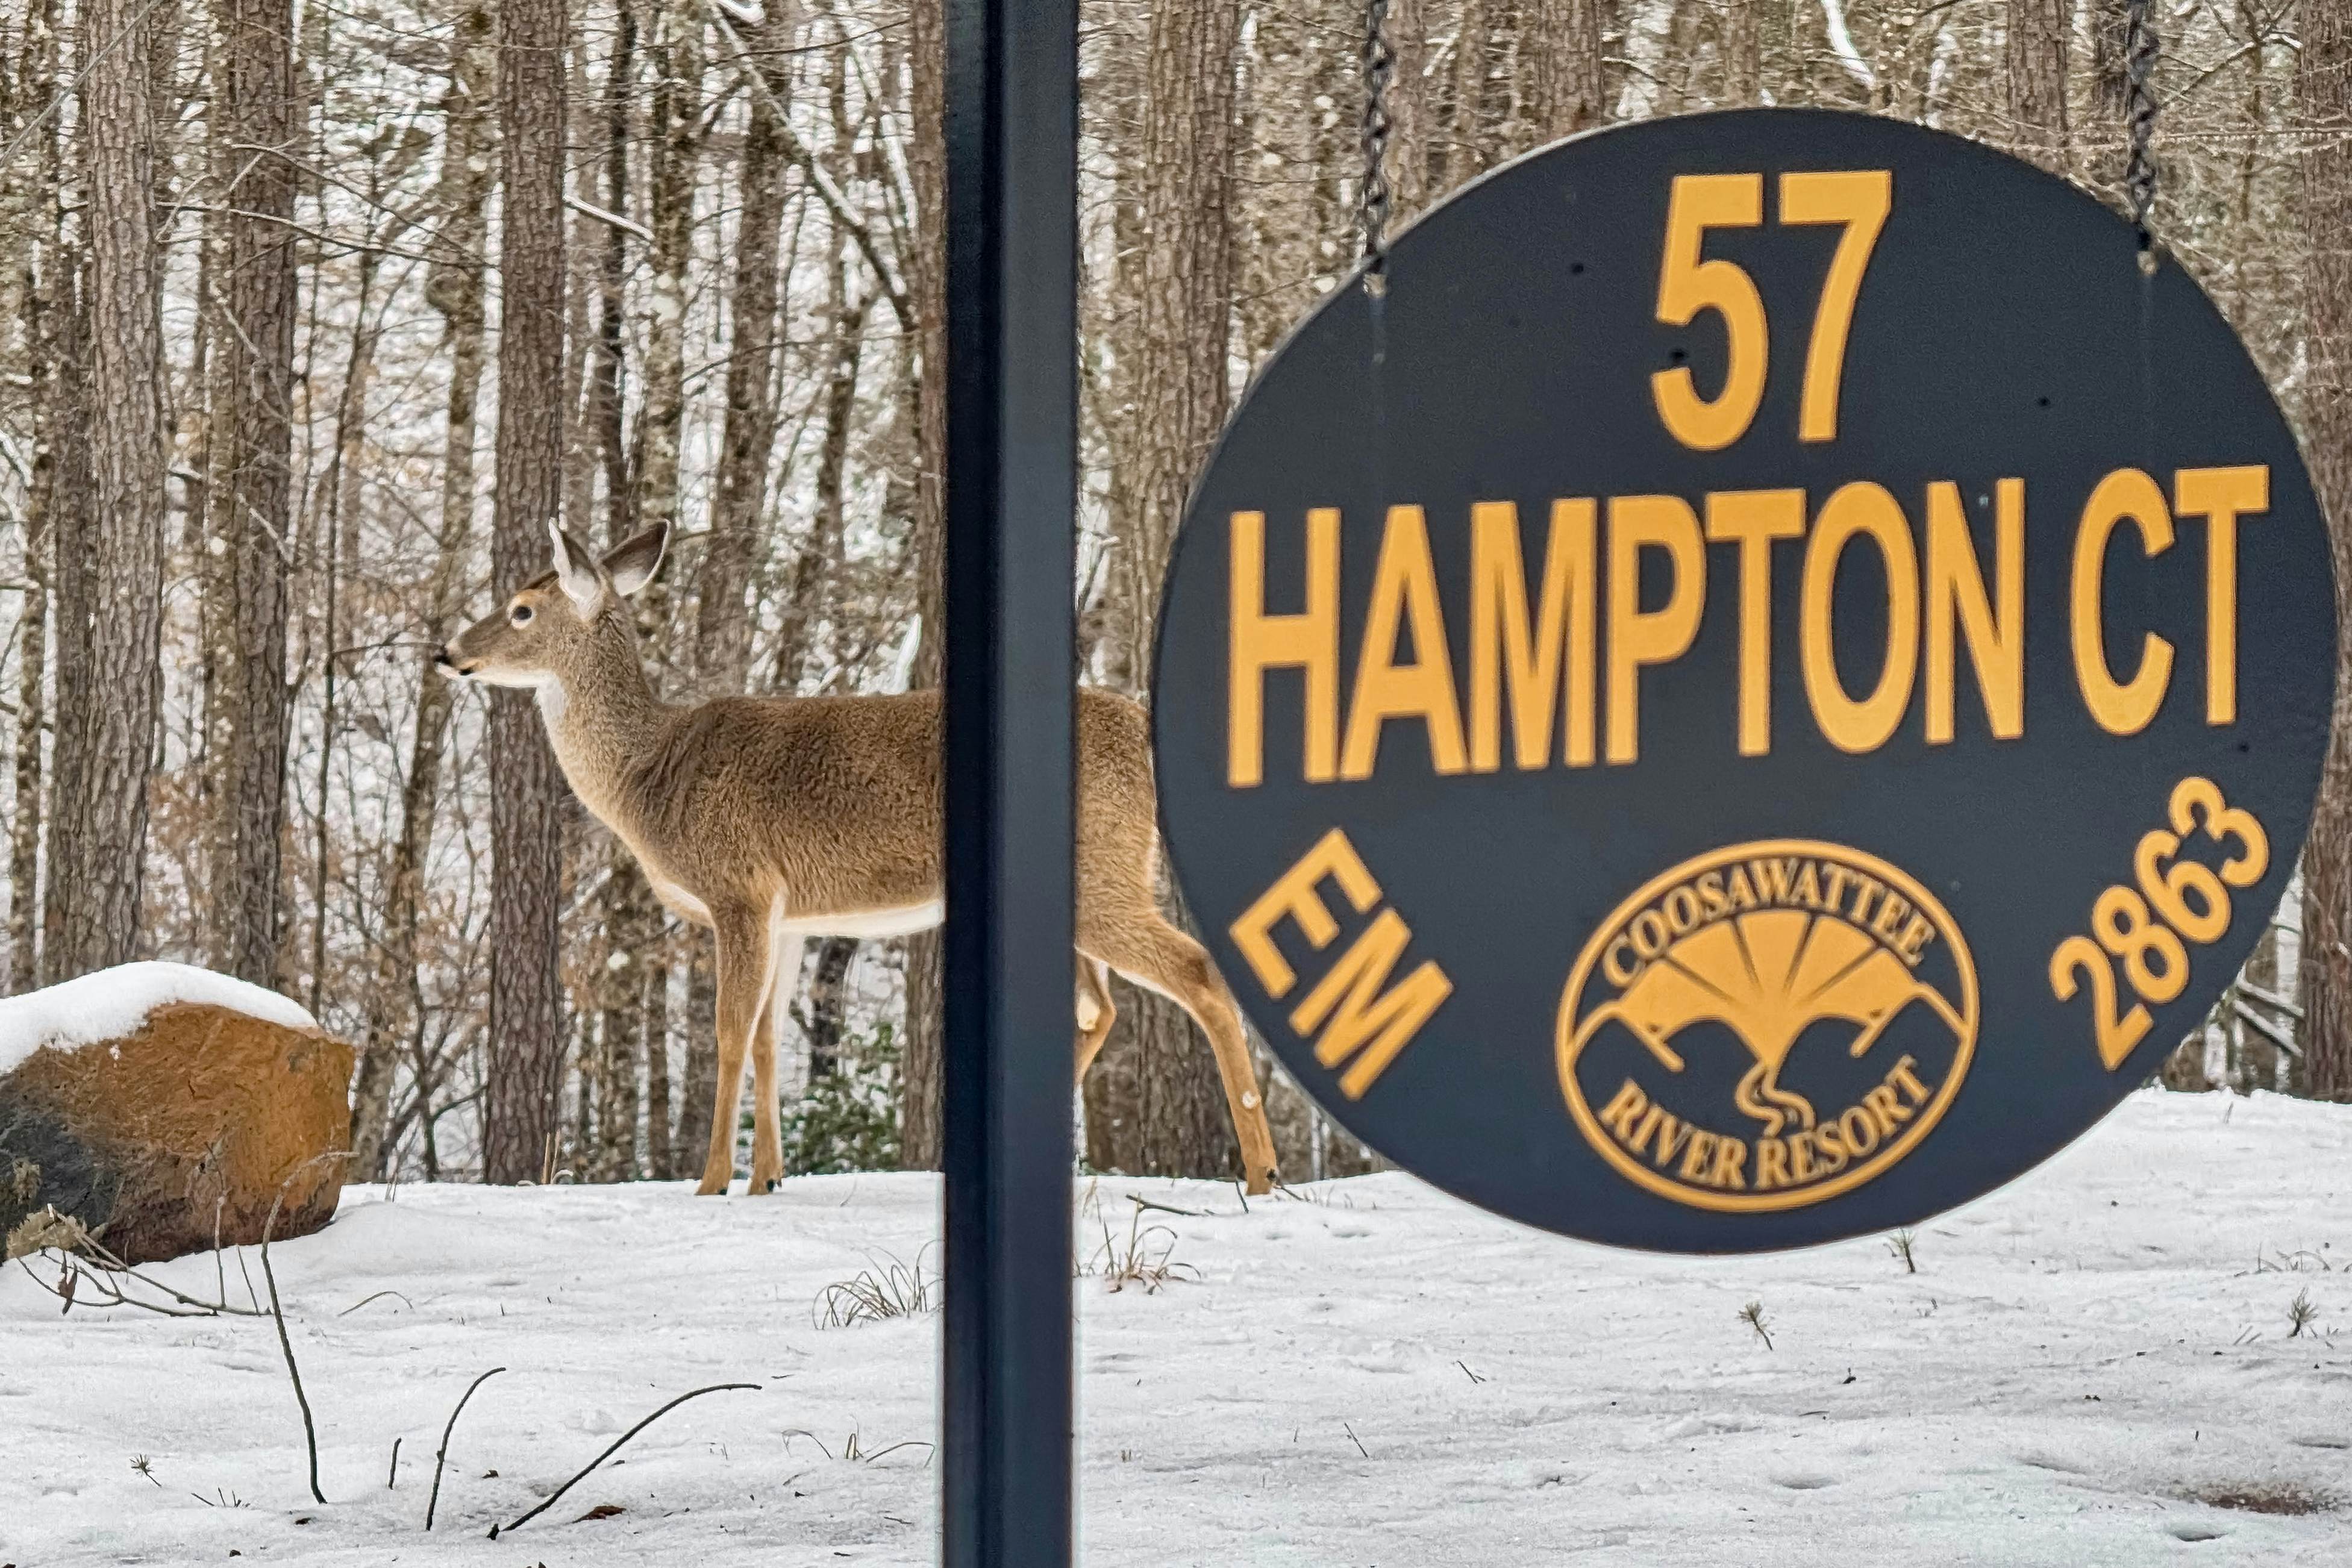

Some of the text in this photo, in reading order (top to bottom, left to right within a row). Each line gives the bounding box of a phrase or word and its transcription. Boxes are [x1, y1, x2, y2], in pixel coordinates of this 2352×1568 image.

[1652, 170, 1892, 451] 57
[1228, 466, 2269, 788] HAMPTON CT
[1230, 831, 1451, 1098] EM
[1603, 858, 1935, 988] COOSAWATTEE
[2049, 777, 2269, 1070] 2863
[1598, 1055, 1932, 1190] RIVER RESORT
